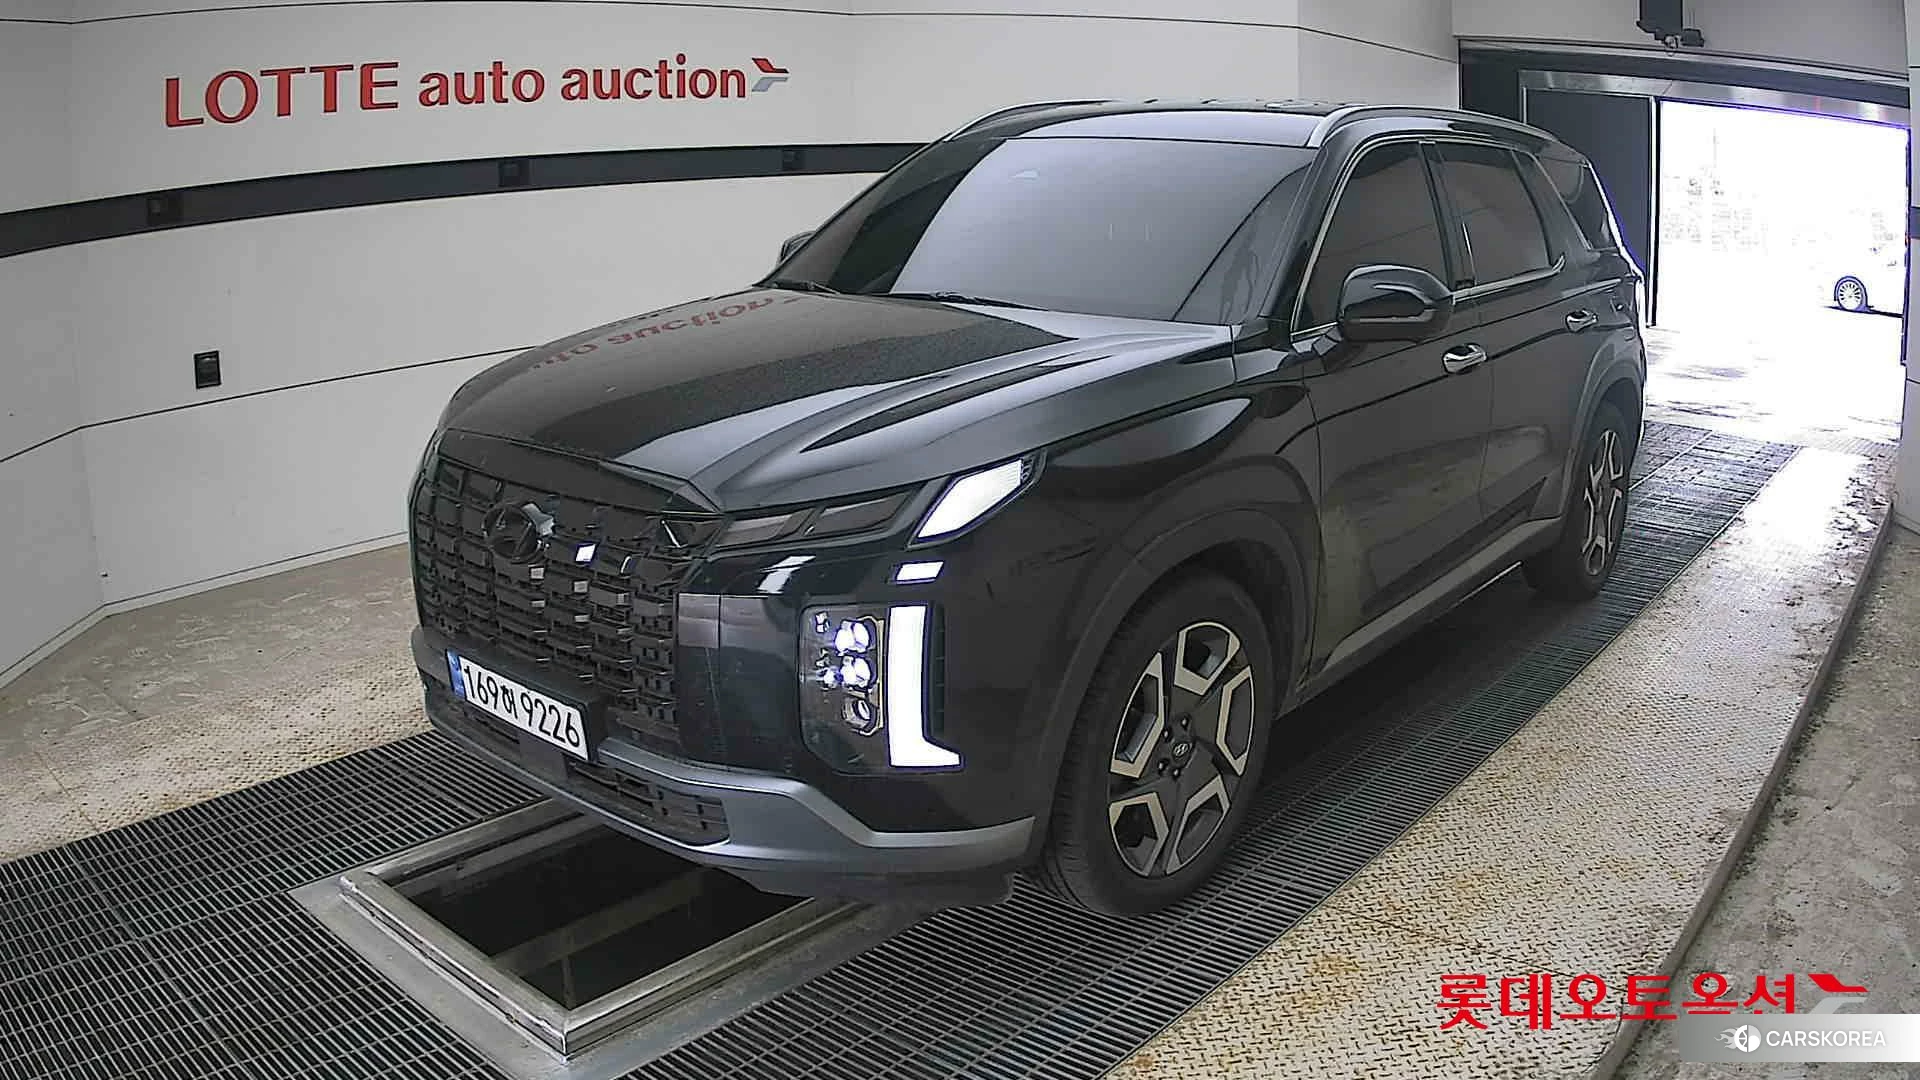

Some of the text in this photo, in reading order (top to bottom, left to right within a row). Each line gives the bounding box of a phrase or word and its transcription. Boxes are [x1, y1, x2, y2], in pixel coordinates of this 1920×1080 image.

[164, 53, 748, 128] LOTTE auto auction
